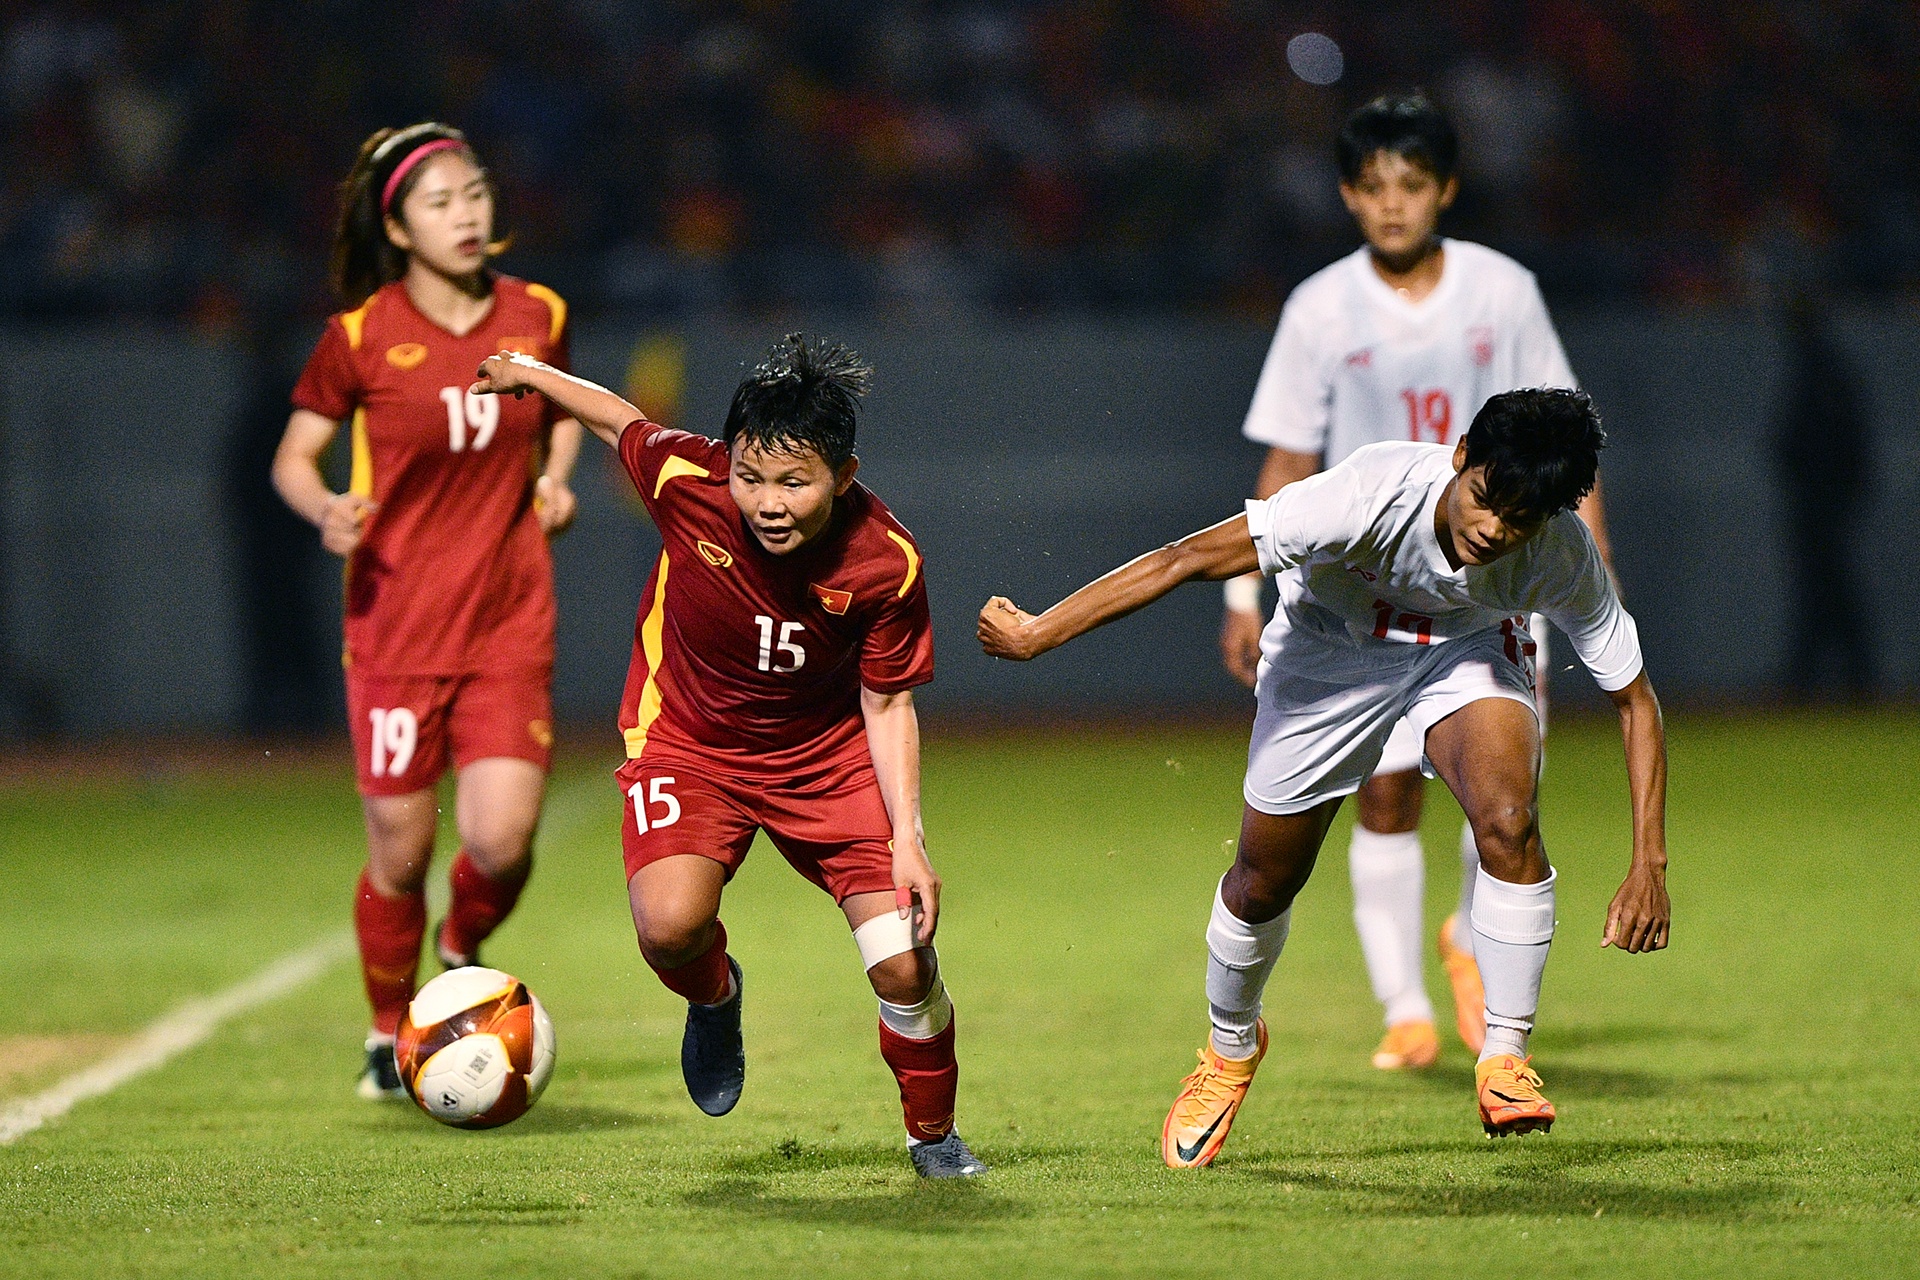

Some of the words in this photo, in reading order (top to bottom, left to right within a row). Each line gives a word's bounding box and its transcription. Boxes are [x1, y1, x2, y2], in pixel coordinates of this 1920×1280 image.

[439, 381, 500, 452] 19
[1400, 387, 1452, 445] 19
[754, 615, 806, 673] 15
[369, 707, 418, 777] 19
[627, 776, 681, 836] 15
